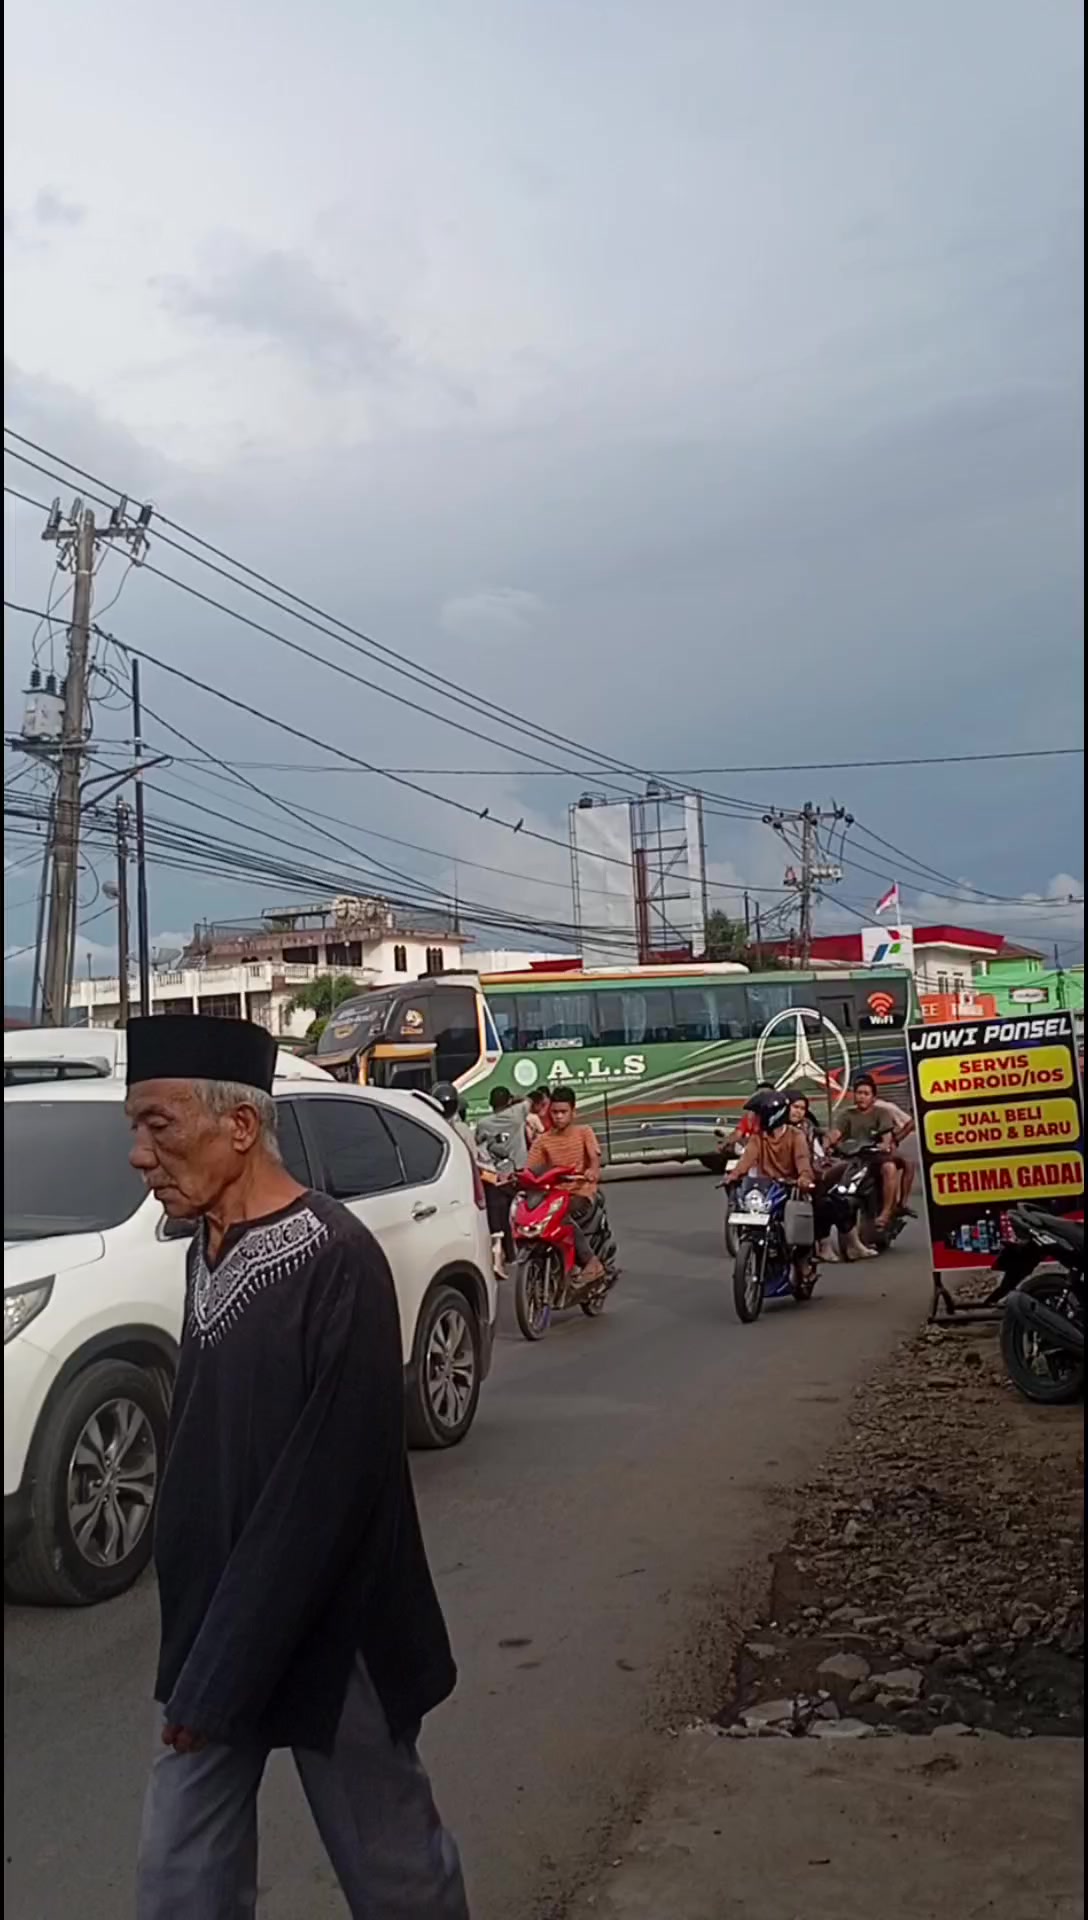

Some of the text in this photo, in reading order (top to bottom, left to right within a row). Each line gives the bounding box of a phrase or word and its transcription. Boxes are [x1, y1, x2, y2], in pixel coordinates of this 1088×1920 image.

[869, 1014, 894, 1025] WiFi
[911, 1017, 1072, 1051] JOWI PONSEL
[547, 1055, 646, 1080] A.L.S
[959, 1054, 1029, 1074] SERVIS
[929, 1068, 1064, 1094] ANDROID/IOS
[958, 1105, 1042, 1126] JUAL BELI
[934, 1120, 1071, 1146] SECOND & BARU
[934, 1161, 1083, 1194] TERIMA GADAI
